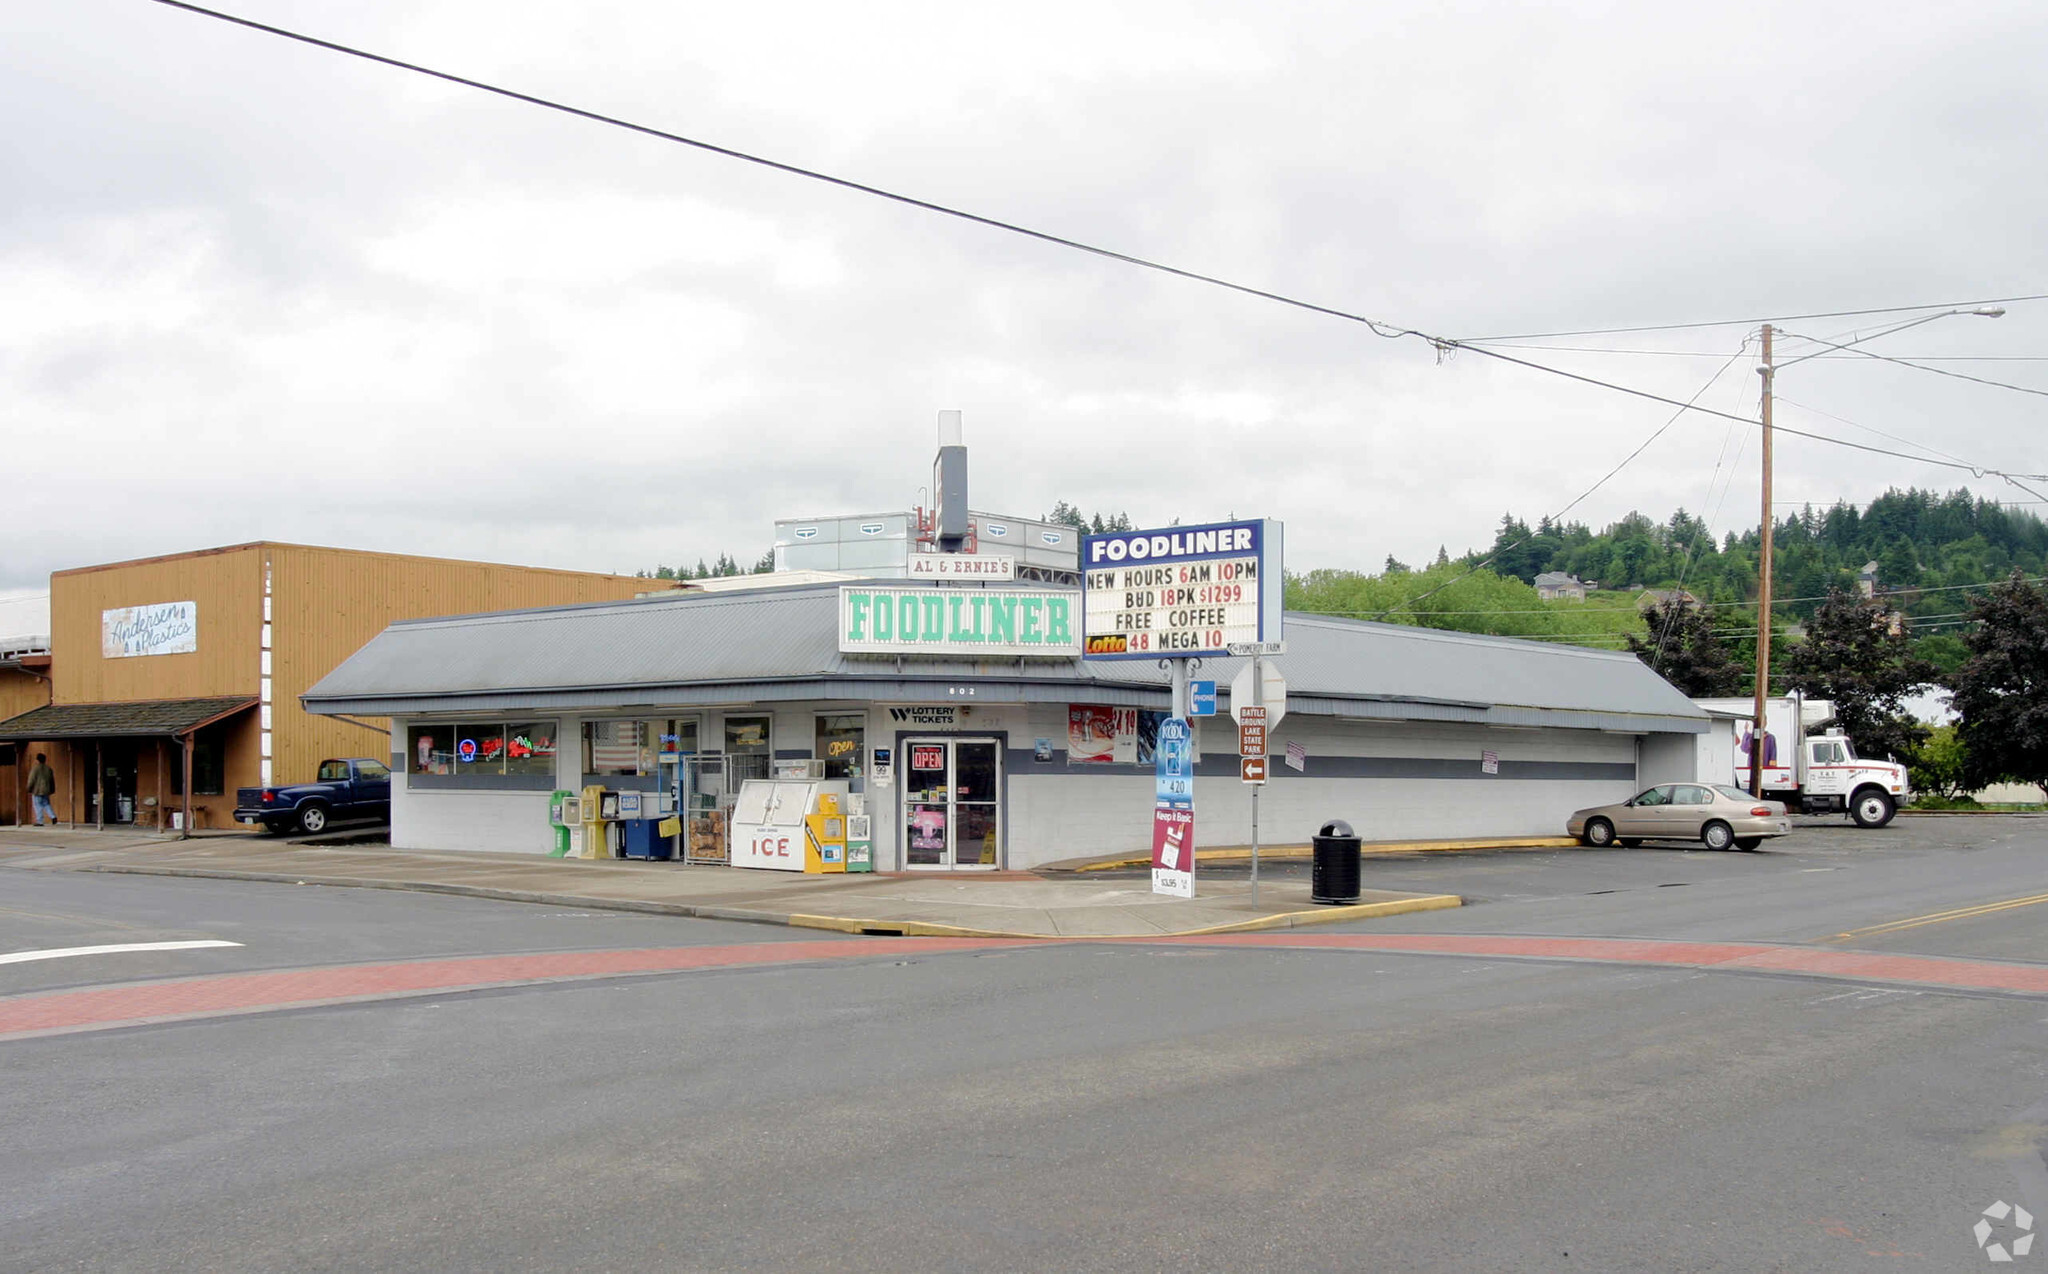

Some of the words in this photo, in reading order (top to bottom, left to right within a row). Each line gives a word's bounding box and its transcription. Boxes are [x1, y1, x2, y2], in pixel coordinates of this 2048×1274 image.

[1092, 529, 1252, 562] FOODLINER
[914, 561, 933, 573] AL
[939, 561, 948, 573] &
[955, 557, 1009, 574] ERNIE'S
[1087, 572, 1115, 590] NEW
[1124, 567, 1173, 587] HOURS
[1179, 564, 1211, 583] 6AM
[1217, 561, 1257, 581] 10PM
[1125, 591, 1155, 608] BUD
[1160, 588, 1196, 606] 18PK
[1200, 584, 1242, 603] $1299
[112, 605, 178, 644] Andersen
[848, 595, 1072, 643] FOODLINER
[1116, 612, 1152, 630] FREE
[1169, 608, 1226, 627] COFFEE
[142, 623, 191, 650] Plastics
[1085, 636, 1127, 655] Lotto
[1129, 633, 1149, 650] 48
[1158, 632, 1200, 649] MEGA
[1205, 630, 1222, 648] 10
[911, 707, 955, 715] LOTTERY
[912, 715, 954, 723] TICKETS
[1241, 708, 1264, 717] BATTLE
[1240, 718, 1265, 726] GROUND
[1244, 727, 1261, 735] LAKE
[829, 740, 855, 757] Open
[1243, 736, 1262, 744] STATE
[1243, 745, 1261, 753] PARK
[914, 752, 942, 768] OPEN
[752, 838, 790, 857] ICE
